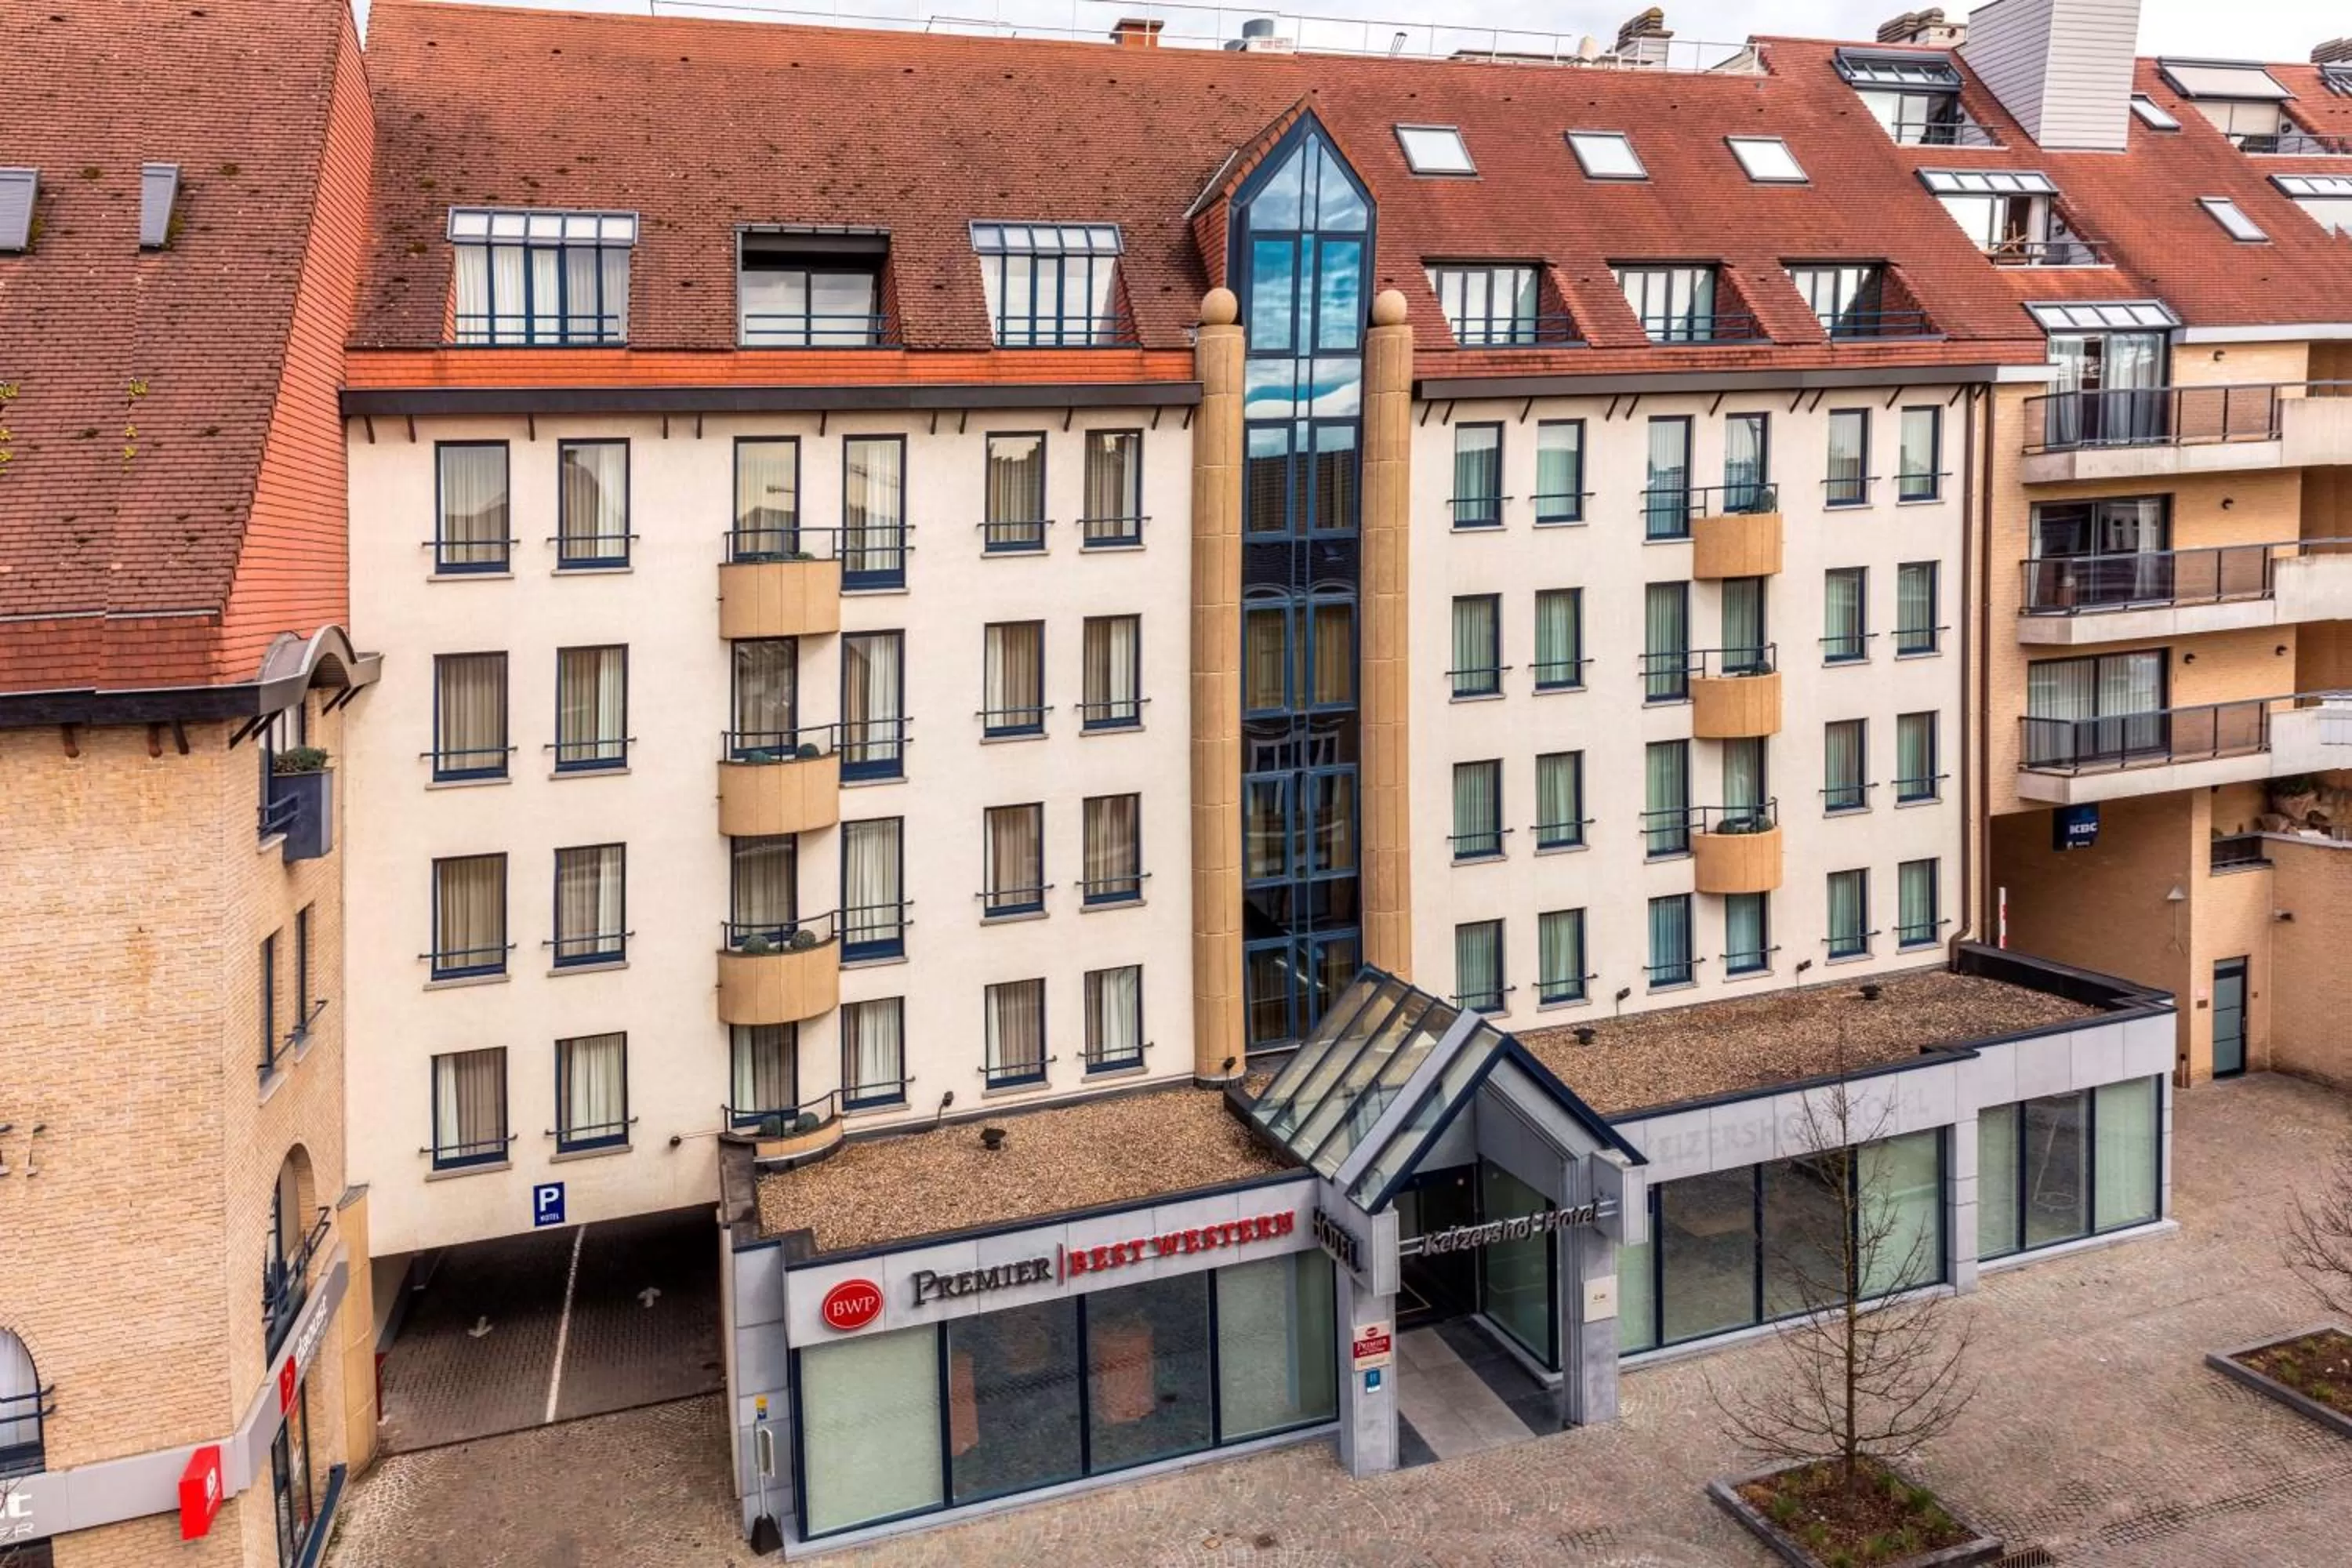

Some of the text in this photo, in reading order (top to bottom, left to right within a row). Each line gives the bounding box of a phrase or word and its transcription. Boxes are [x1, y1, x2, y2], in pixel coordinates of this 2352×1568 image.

[2069, 822, 2098, 834] KBC
[1646, 1106, 1820, 1162] KEIZERSHO
[539, 1187, 559, 1211] P
[1069, 1239, 1145, 1277] BEST
[1153, 1210, 1296, 1257] WESTERN
[833, 1296, 877, 1317] BWP
